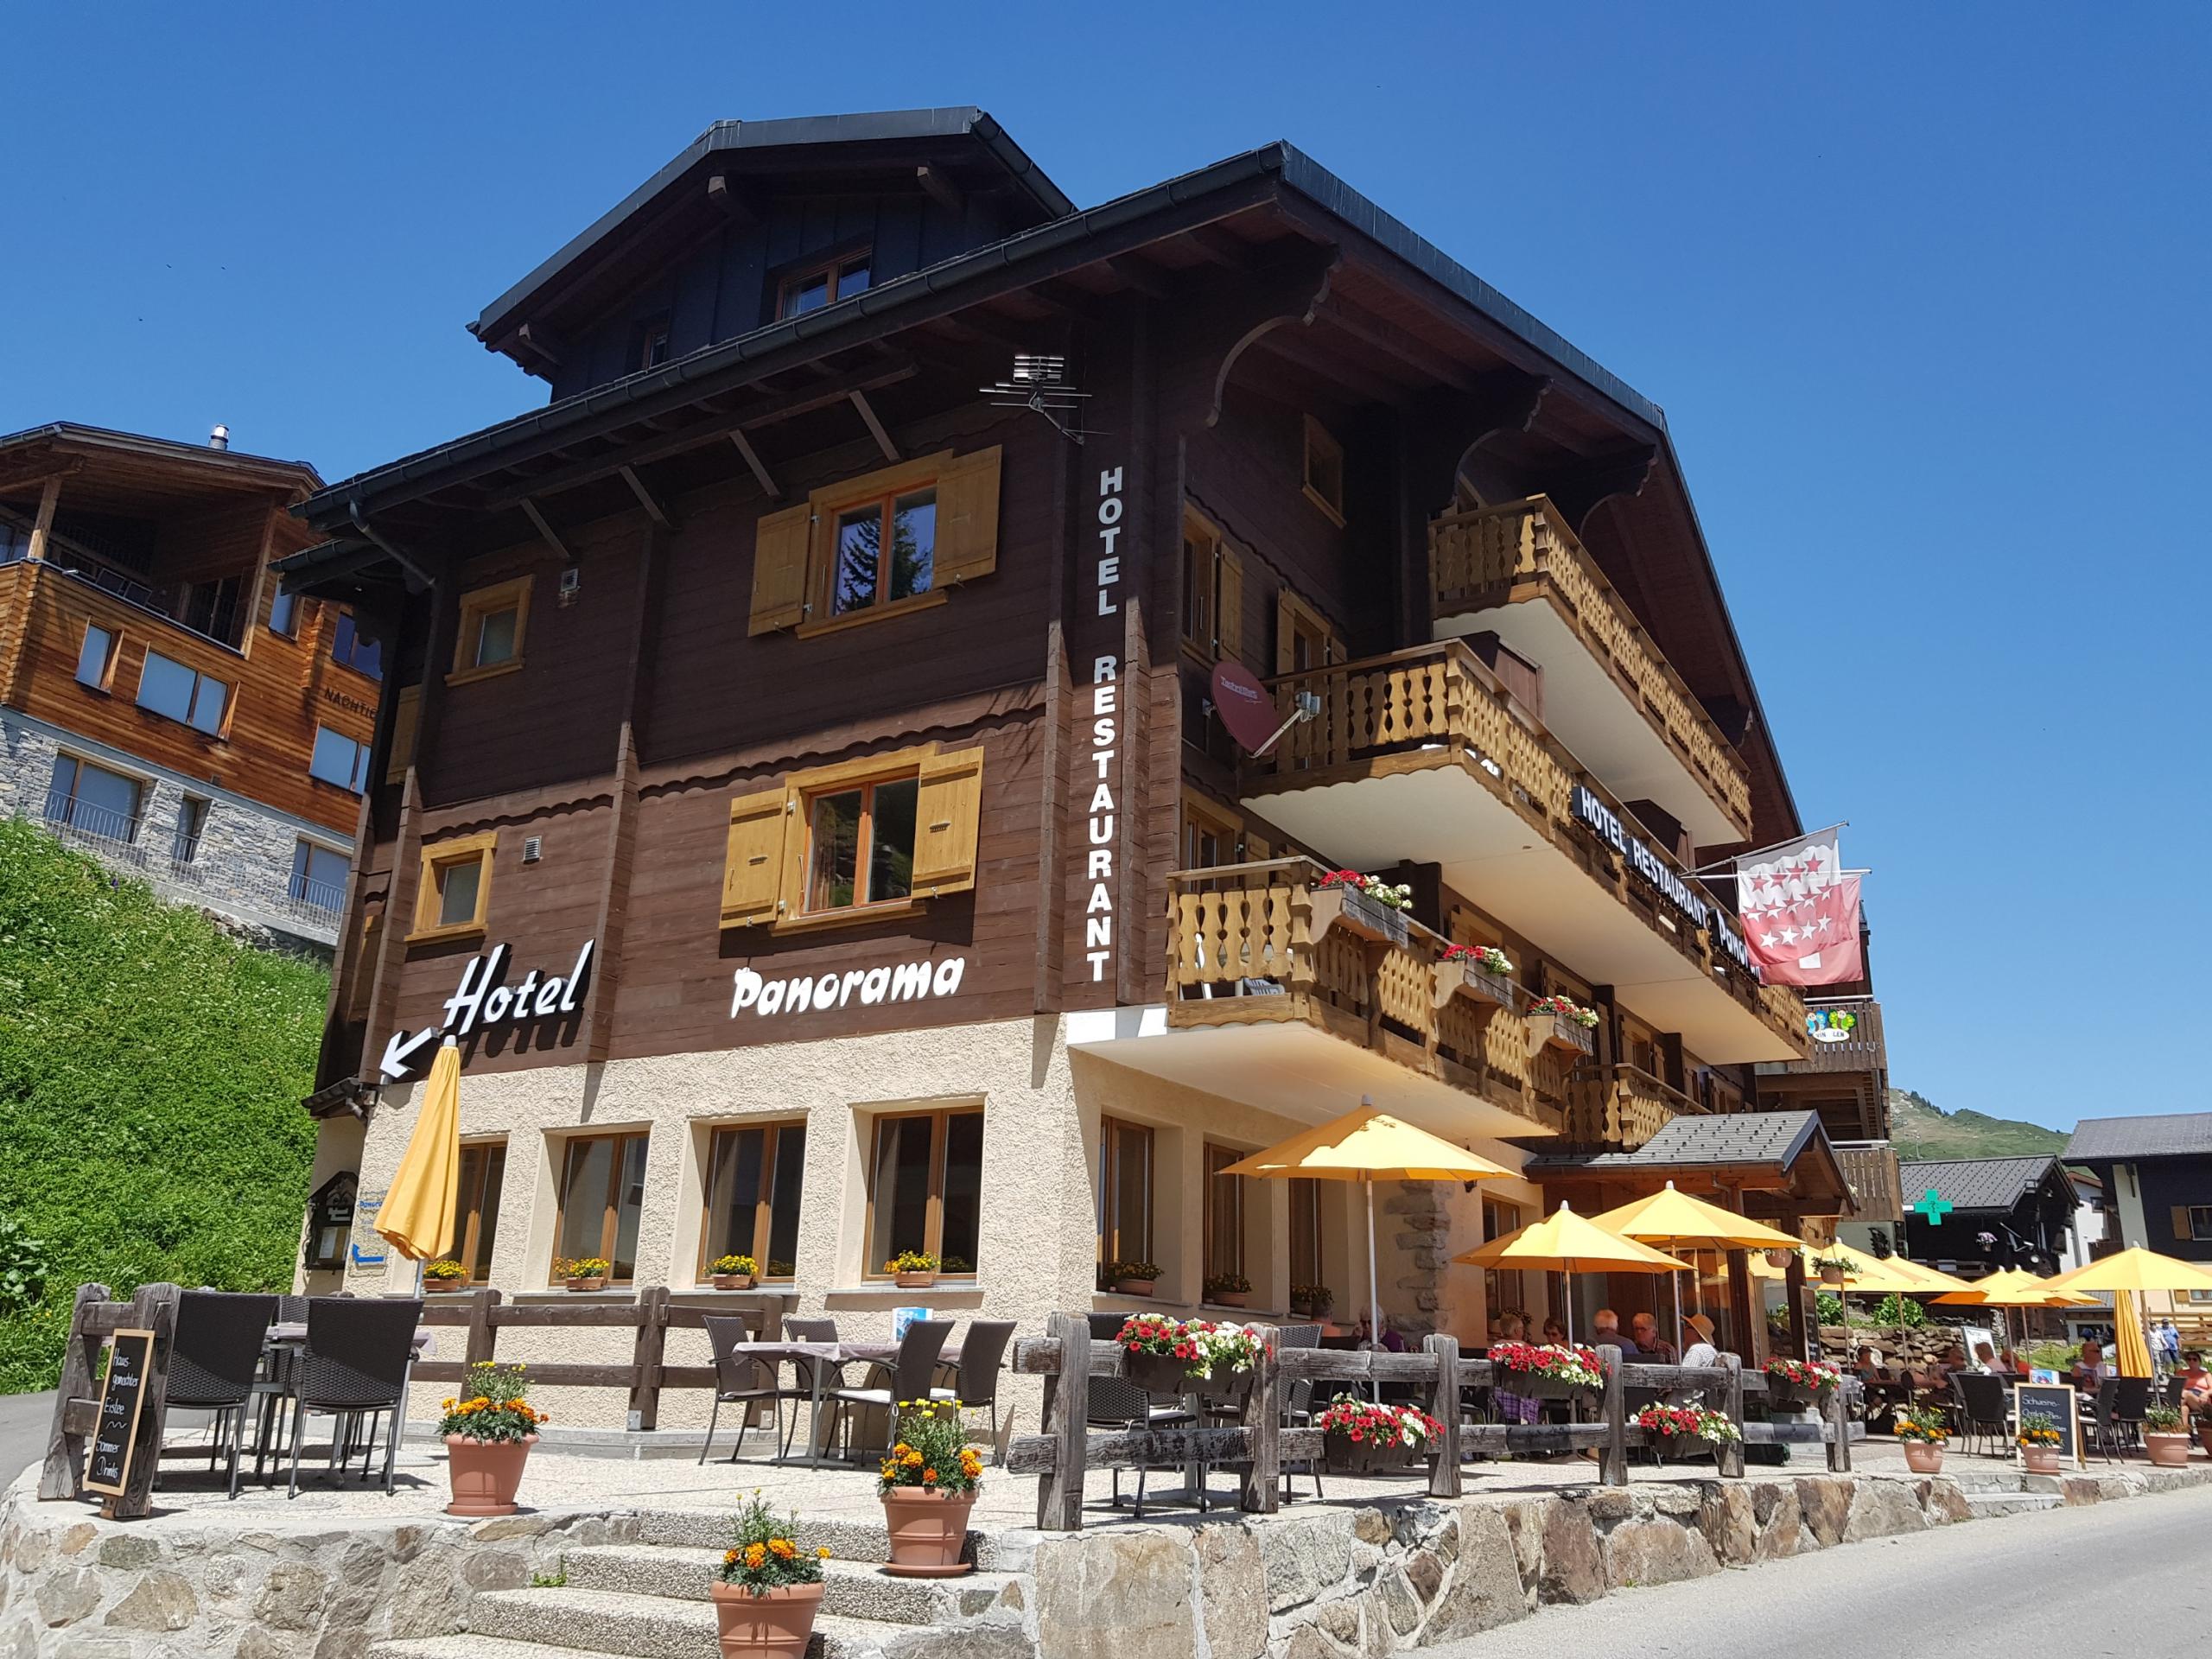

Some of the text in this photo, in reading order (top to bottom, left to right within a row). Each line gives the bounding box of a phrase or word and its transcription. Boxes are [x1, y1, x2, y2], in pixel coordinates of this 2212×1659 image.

[1086, 466, 1122, 982] HOTEL RESTAURANT
[1580, 785, 1628, 855] HOTEL
[1632, 836, 1710, 931] RESTAURANT
[442, 938, 594, 1036] Hotel
[731, 957, 965, 1020] Panorama
